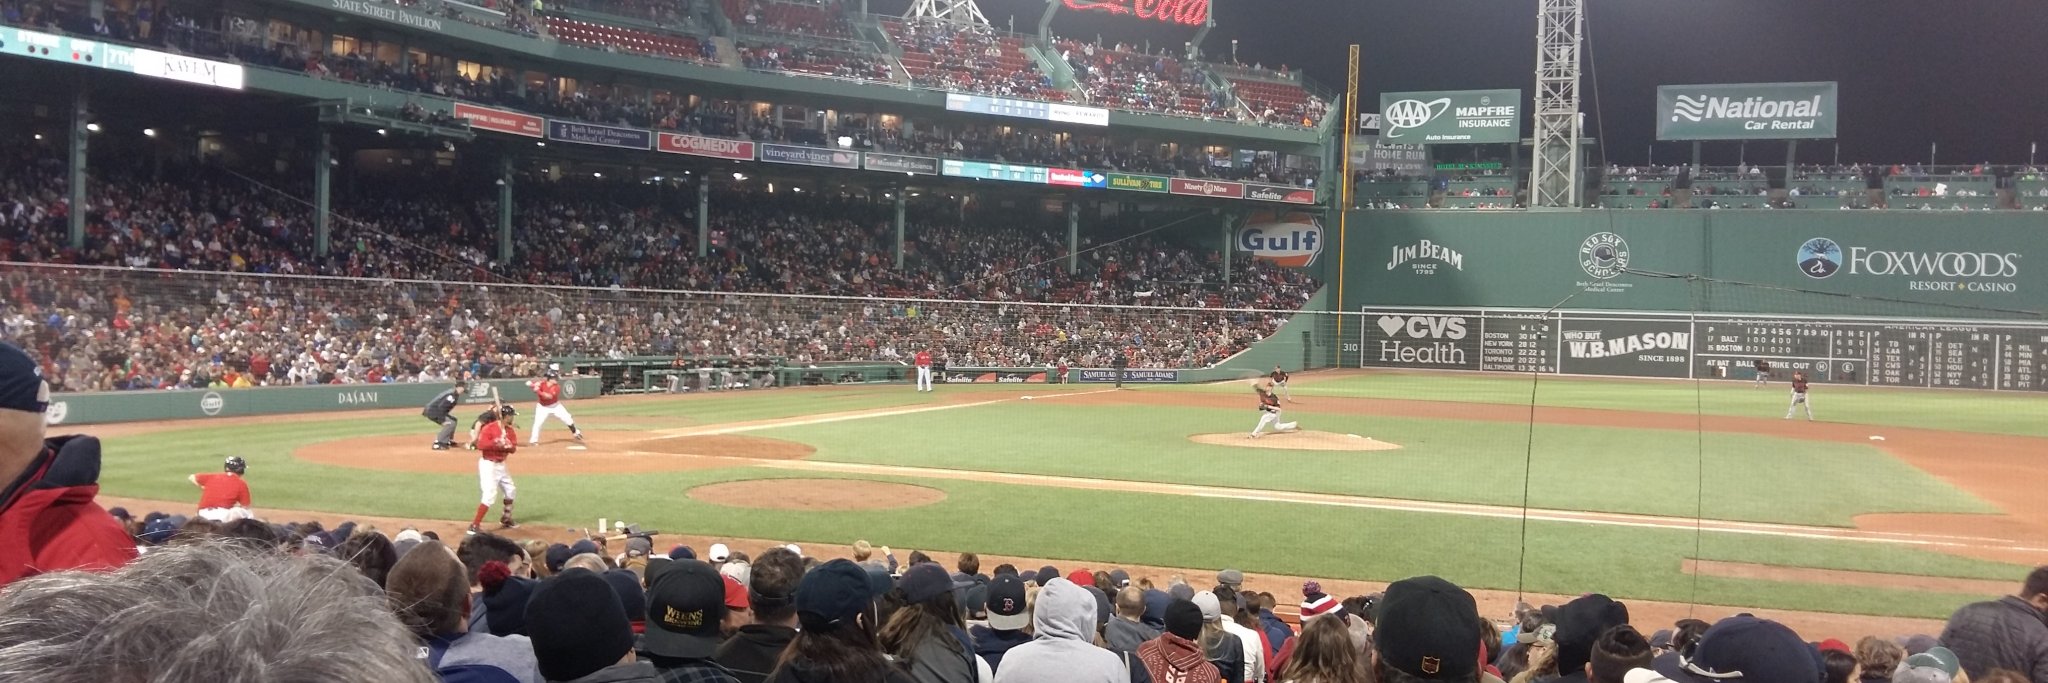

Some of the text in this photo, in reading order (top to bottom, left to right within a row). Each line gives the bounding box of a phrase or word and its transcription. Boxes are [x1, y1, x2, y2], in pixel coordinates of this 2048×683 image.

[332, 0, 441, 31] STATE STREET PAVILION
[1455, 106, 1515, 117] MAPFRE
[1705, 94, 1821, 119] National
[1458, 119, 1511, 128] INSURANCE
[1744, 119, 1815, 130] Car Rental
[571, 124, 641, 141] Beth Israel Deaconess
[571, 132, 621, 145] Medical Center
[671, 135, 741, 154] COGMEDIX
[765, 148, 830, 163] vineyard vines
[1373, 150, 1426, 161] HOME RUN
[877, 159, 903, 168] Museum
[910, 162, 934, 171] Science
[1112, 177, 1163, 189] SULLIVAN TIRE
[1184, 182, 1227, 193] Ninety Nine
[1251, 190, 1282, 200] Safelite
[1241, 228, 1317, 252] Gulf
[1581, 234, 1621, 254] RED SOX
[1386, 239, 1463, 272] JIM BEAM
[1848, 246, 2017, 277] FOXWOODS
[1909, 280, 2017, 293] RESORT CASINO
[1406, 315, 1467, 340] CVS
[1753, 327, 1759, 335] 2
[1761, 327, 1767, 335] 3
[1785, 328, 1792, 336] 6
[1796, 328, 1801, 336] 7
[1810, 329, 1817, 337] 9
[1820, 329, 1829, 337] 10
[1563, 332, 1601, 340] WHO BUT
[1721, 335, 1739, 343] BALT
[1874, 330, 1880, 338] P
[1935, 332, 1942, 340] P
[1971, 333, 1980, 341] IN
[1983, 333, 1990, 341] R
[2005, 334, 2012, 342] P
[1343, 343, 1359, 352] 310
[1569, 331, 1690, 359] W.B.MASON
[1715, 344, 1743, 352] BOSTON
[1888, 340, 1899, 348] TB
[1908, 344, 1915, 352] N
[1947, 342, 1963, 350] DET
[2018, 344, 2032, 352] MIL
[1379, 340, 1467, 364] Health
[1948, 349, 1963, 357] SEA
[1735, 360, 1756, 368] BALL
[1792, 362, 1811, 370] OUT
[2018, 359, 2032, 367] MIA
[1083, 370, 1128, 379] SAMUEL ADS
[1131, 370, 1174, 379] SAMUEL ADAMS
[1946, 371, 1962, 379] NYY
[2017, 366, 2032, 374] ATL
[1948, 378, 1960, 386] KC
[338, 390, 378, 405] DASANI
[202, 400, 221, 408] Gulf
[1002, 597, 1015, 612] B
